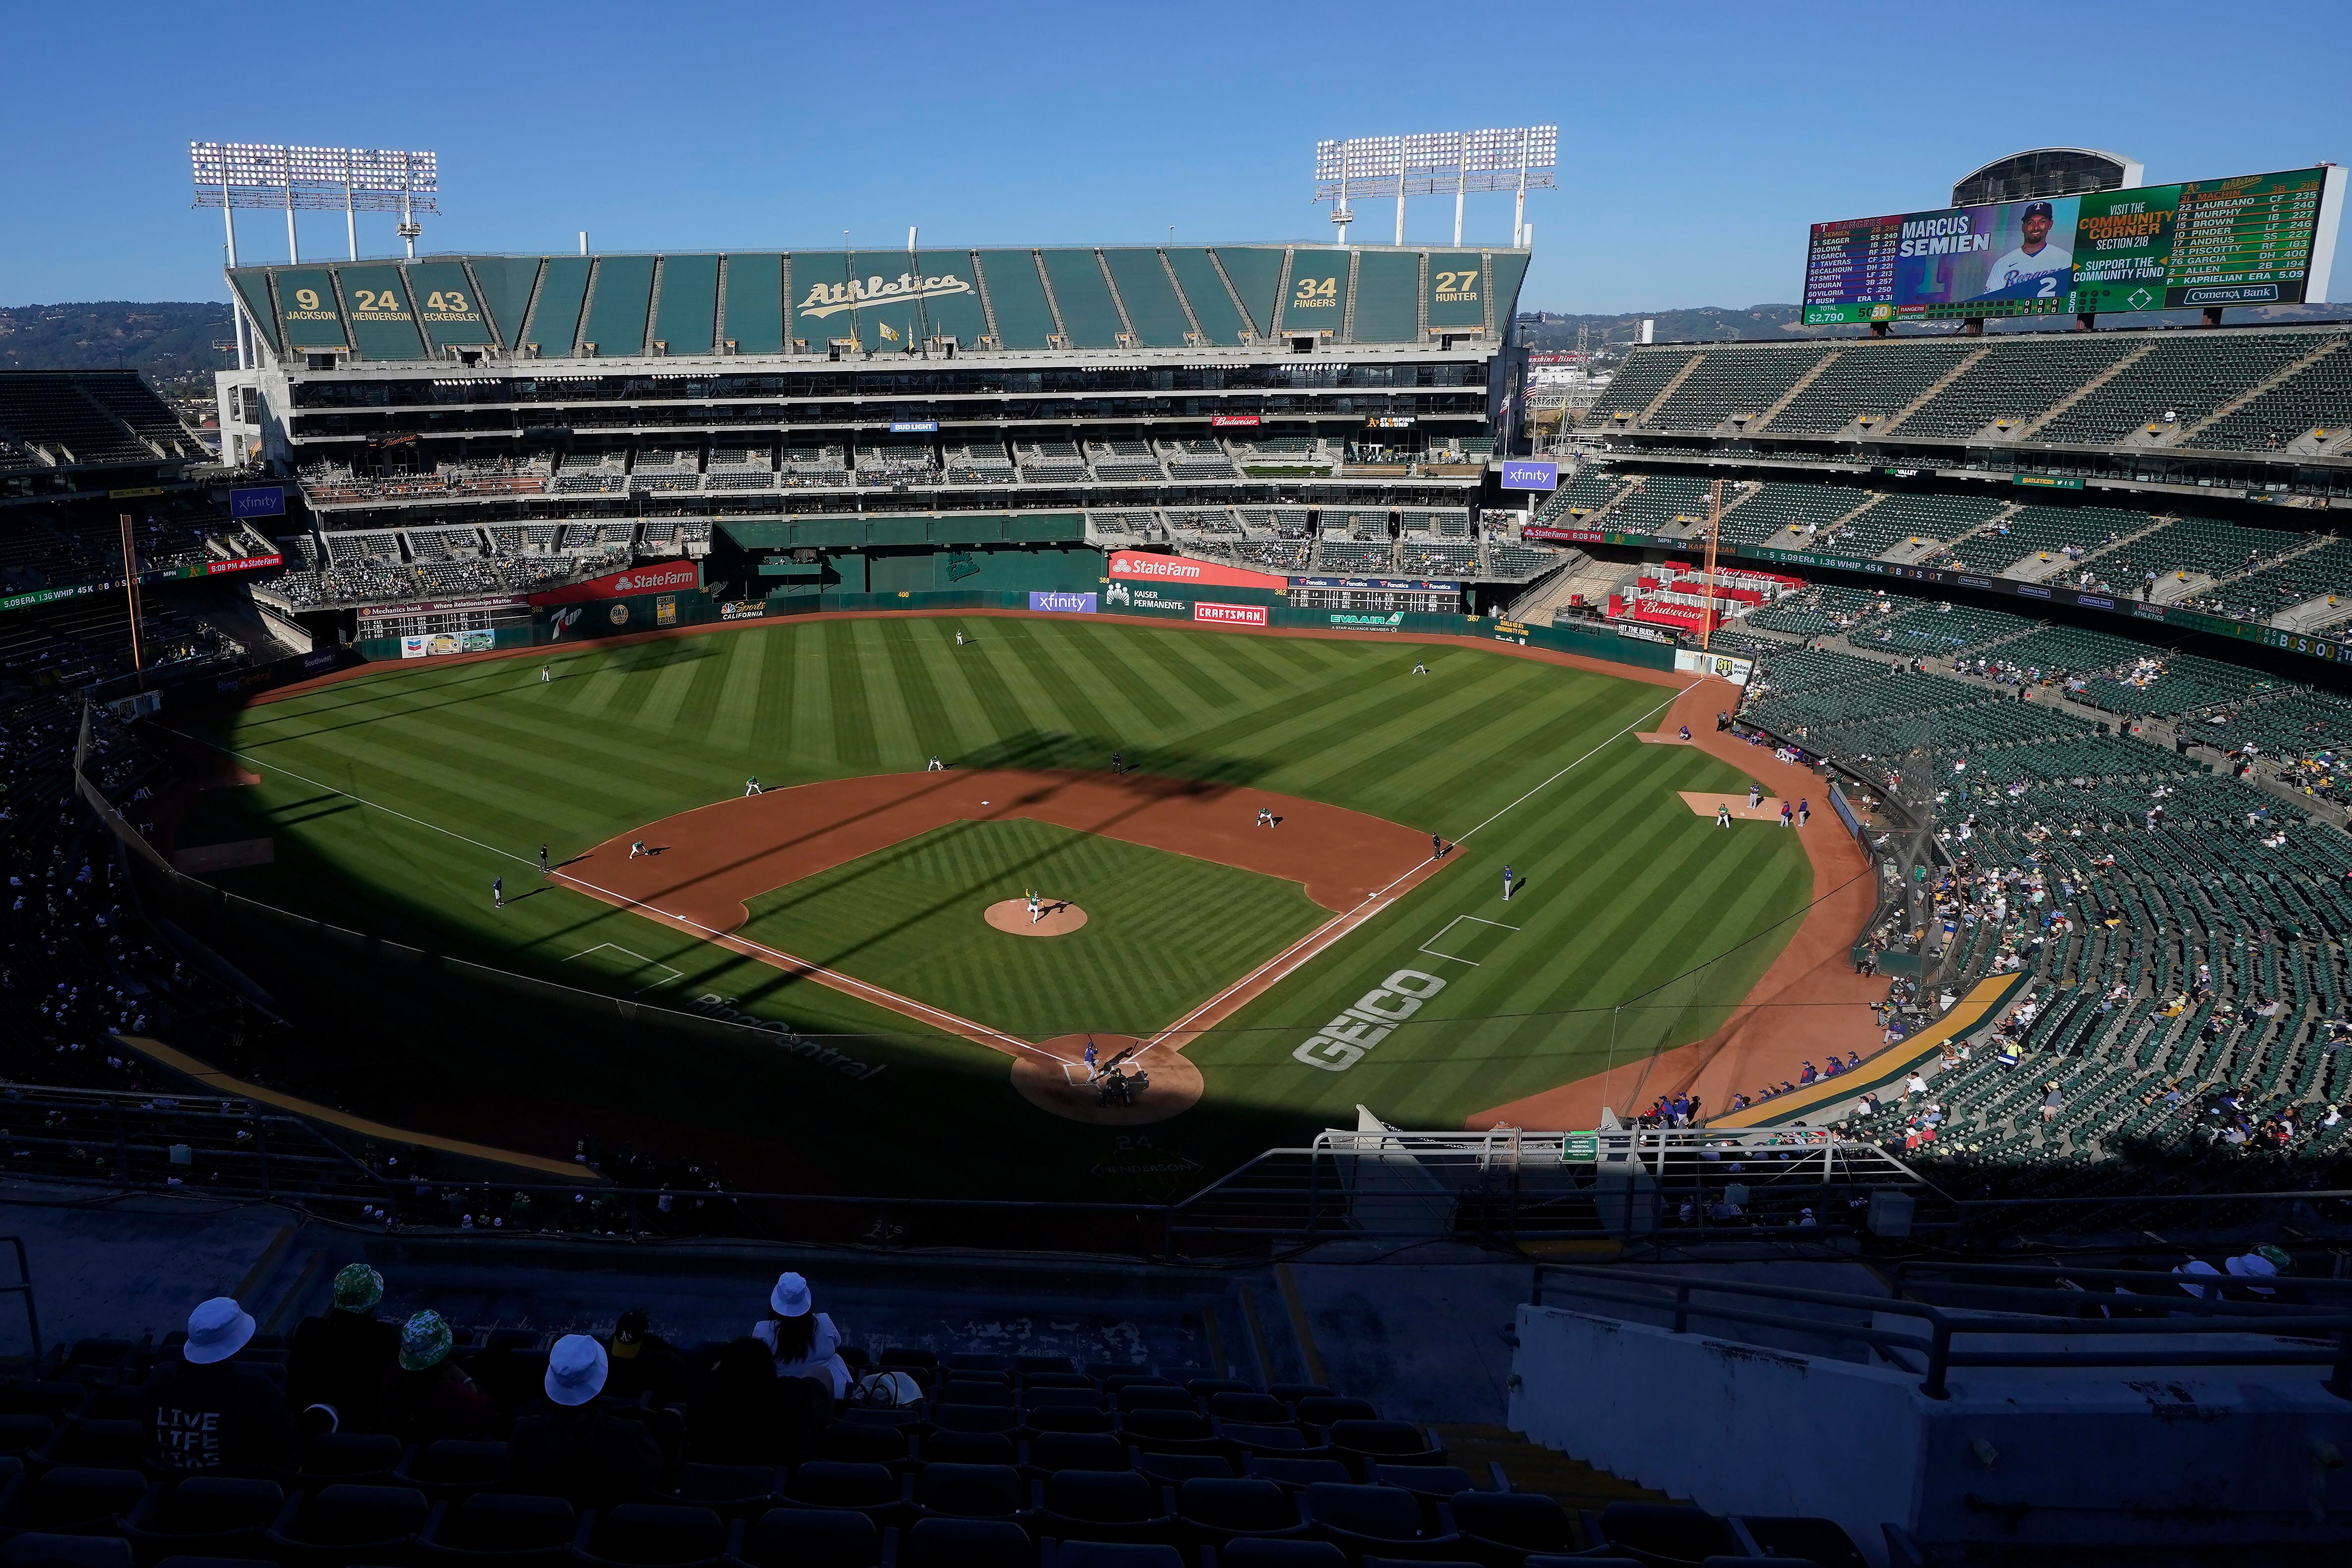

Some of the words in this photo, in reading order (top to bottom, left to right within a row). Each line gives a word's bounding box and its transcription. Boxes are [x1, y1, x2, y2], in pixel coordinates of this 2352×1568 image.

[2195, 197, 2254, 210] LAUREANO
[2292, 191, 2317, 201] .235
[2197, 190, 2242, 201] MACHIN
[2110, 203, 2129, 216] VISIT
[2131, 202, 2145, 213] THE
[2194, 208, 2242, 219] MURPHY
[2290, 200, 2315, 210] .240
[1835, 219, 1882, 230] RANGERS
[2080, 210, 2175, 230] COMMUNITY
[2193, 218, 2234, 228] BROWN
[2289, 210, 2314, 219] .227
[1902, 215, 1969, 239] MARCUS
[2089, 222, 2160, 240] CORNER
[2191, 227, 2231, 237] PINDER
[2287, 220, 2312, 229] .246
[1900, 232, 1990, 258] SEMIEN
[2096, 237, 2133, 251] SECTION
[2134, 236, 2149, 248] 218
[2190, 236, 2235, 246] ANDRUS
[2286, 230, 2310, 239] .227
[2189, 245, 2243, 255] PISCOTTY
[2286, 240, 2308, 248] .183
[1820, 259, 1852, 267] TAVERAS
[2187, 256, 2227, 264] GARCIA
[2281, 249, 2307, 258] .400
[2085, 259, 2132, 271] SUPPORT
[2134, 257, 2154, 267] THE
[2185, 265, 2220, 274] ALLEN
[2073, 269, 2134, 282] COMMUNITY
[2136, 267, 2164, 278] FUND
[2184, 273, 2243, 284] KAPRIELIAN
[2248, 272, 2271, 280] ERA
[2279, 270, 2304, 279] 5.09
[1296, 277, 1336, 298] 34
[1436, 271, 1478, 293] 27
[2037, 277, 2057, 298] 2
[797, 272, 969, 315] Athletics
[1436, 293, 1478, 302] HUNTER
[2244, 287, 2271, 297] Bank
[296, 289, 320, 310] 9
[355, 290, 399, 311] 24
[427, 291, 469, 312] 43
[1293, 299, 1336, 309] FINGERS
[286, 311, 336, 320] JACKSON
[352, 312, 412, 321] HENDERSON
[425, 313, 480, 322] ECKERSLEY
[1809, 313, 1844, 323] $2,790
[1215, 417, 1258, 425] Budweiser
[1367, 417, 1380, 427] A's
[381, 434, 416, 449] Treehouse
[1509, 470, 1550, 484] xfinity
[239, 496, 277, 511] xfinity
[211, 564, 226, 573] 6:08
[1820, 558, 1835, 567] 1.36
[1837, 560, 1861, 570] WHIP
[1710, 566, 1776, 581] Budweiser
[4, 598, 20, 608] 5.09
[21, 596, 36, 605] ERA
[40, 592, 53, 601] 1.36
[53, 588, 74, 599] WHIP
[1134, 590, 1159, 599] KAISER
[454, 599, 492, 608] Relationships
[735, 601, 766, 614] Sports
[1040, 593, 1087, 612] xfinity
[1134, 600, 1183, 610] PERMANENTE
[2138, 603, 2163, 614] RANGERS
[723, 611, 763, 620] CALIFORNIA
[1199, 608, 1261, 621] CRAFTSMAN
[1641, 600, 1704, 620] Budweiser
[2133, 610, 2165, 622] ATHLETICS
[1628, 626, 1639, 634] THE
[1639, 627, 1655, 636] BUDS
[305, 654, 332, 668] Southwest
[1682, 651, 1696, 659] 330
[1717, 659, 1732, 672] 811
[218, 669, 272, 692] RingCentral
[1292, 968, 1447, 1072] GEICO
[686, 993, 888, 1081] RingCentral
[1116, 1134, 1153, 1150] 24
[1101, 1163, 1189, 1173] HENDERSON
[157, 1407, 219, 1430] LIVE
[157, 1429, 219, 1451] LIFE
